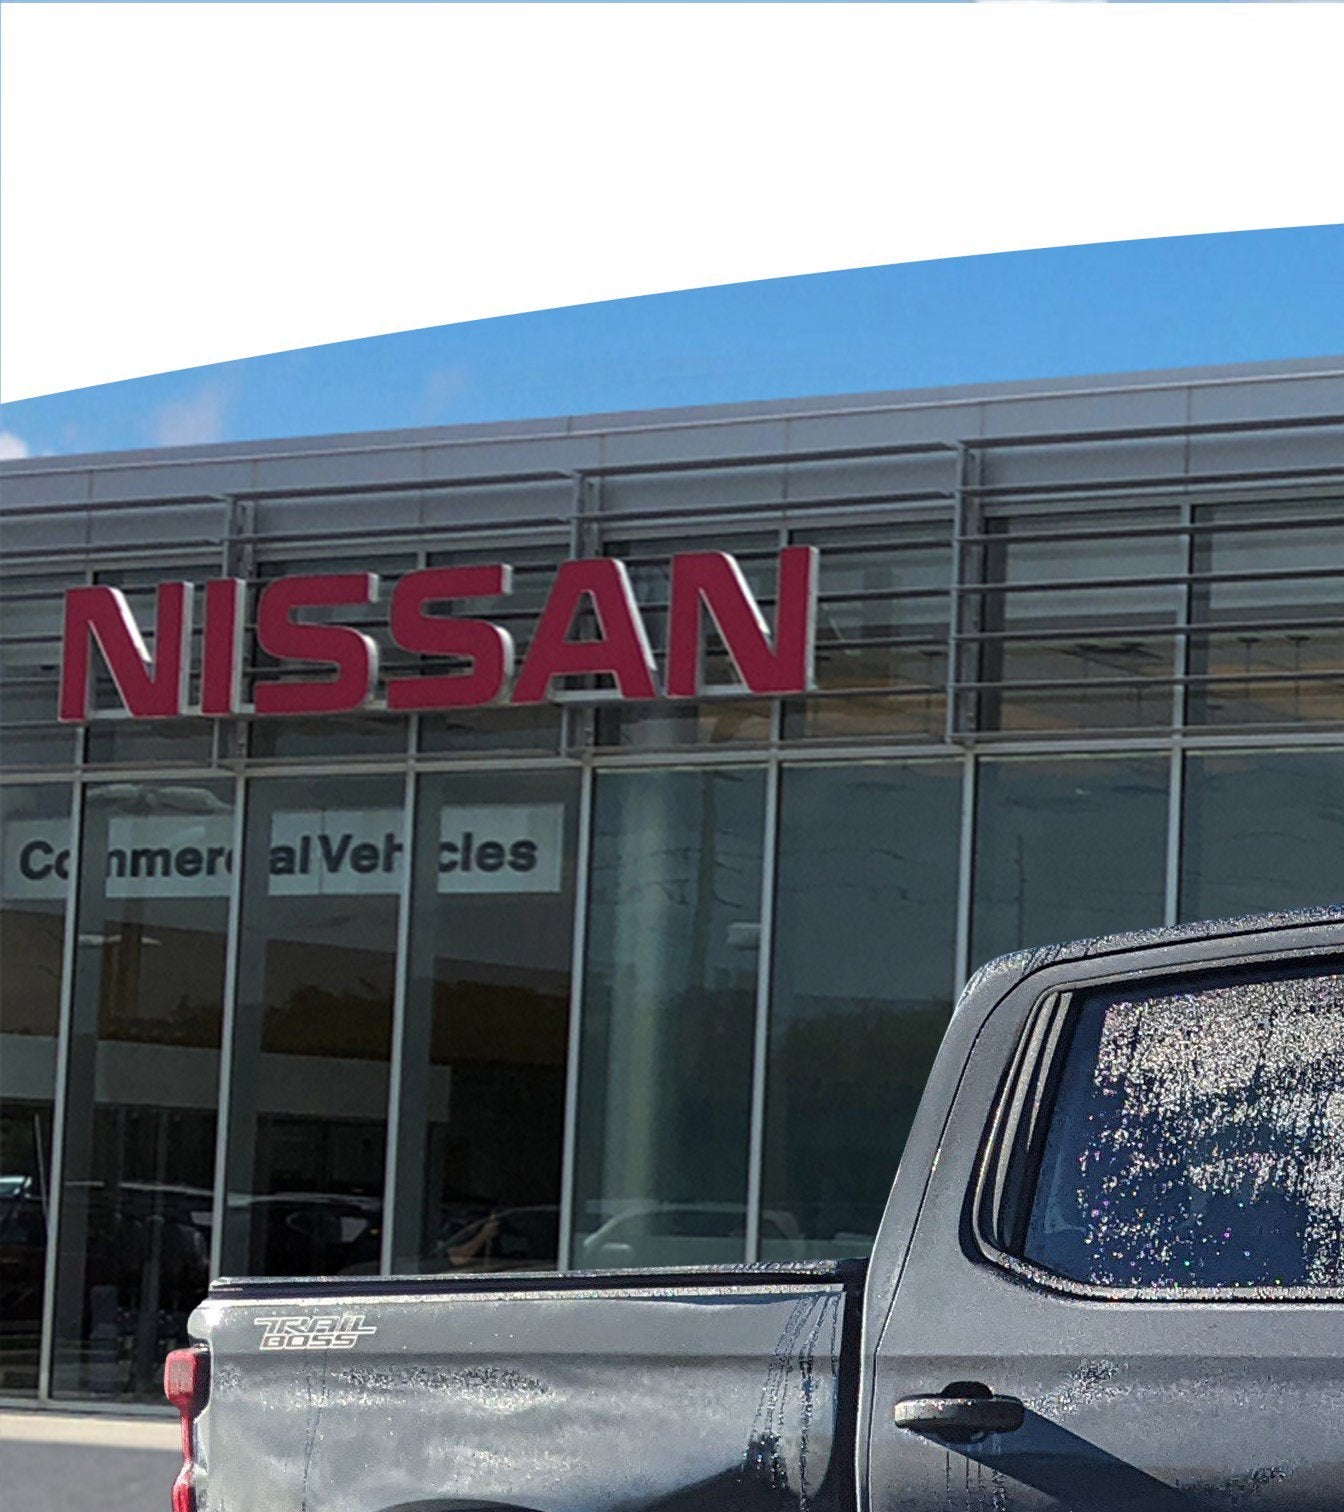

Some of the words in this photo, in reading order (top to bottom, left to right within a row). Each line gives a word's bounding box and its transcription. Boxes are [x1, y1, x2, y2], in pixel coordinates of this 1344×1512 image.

[58, 545, 819, 723] NISSAN
[19, 835, 311, 881] Commeral
[317, 831, 539, 875] Vehcles
[254, 1311, 377, 1335] TRAIL
[259, 1333, 360, 1351] BOSS
